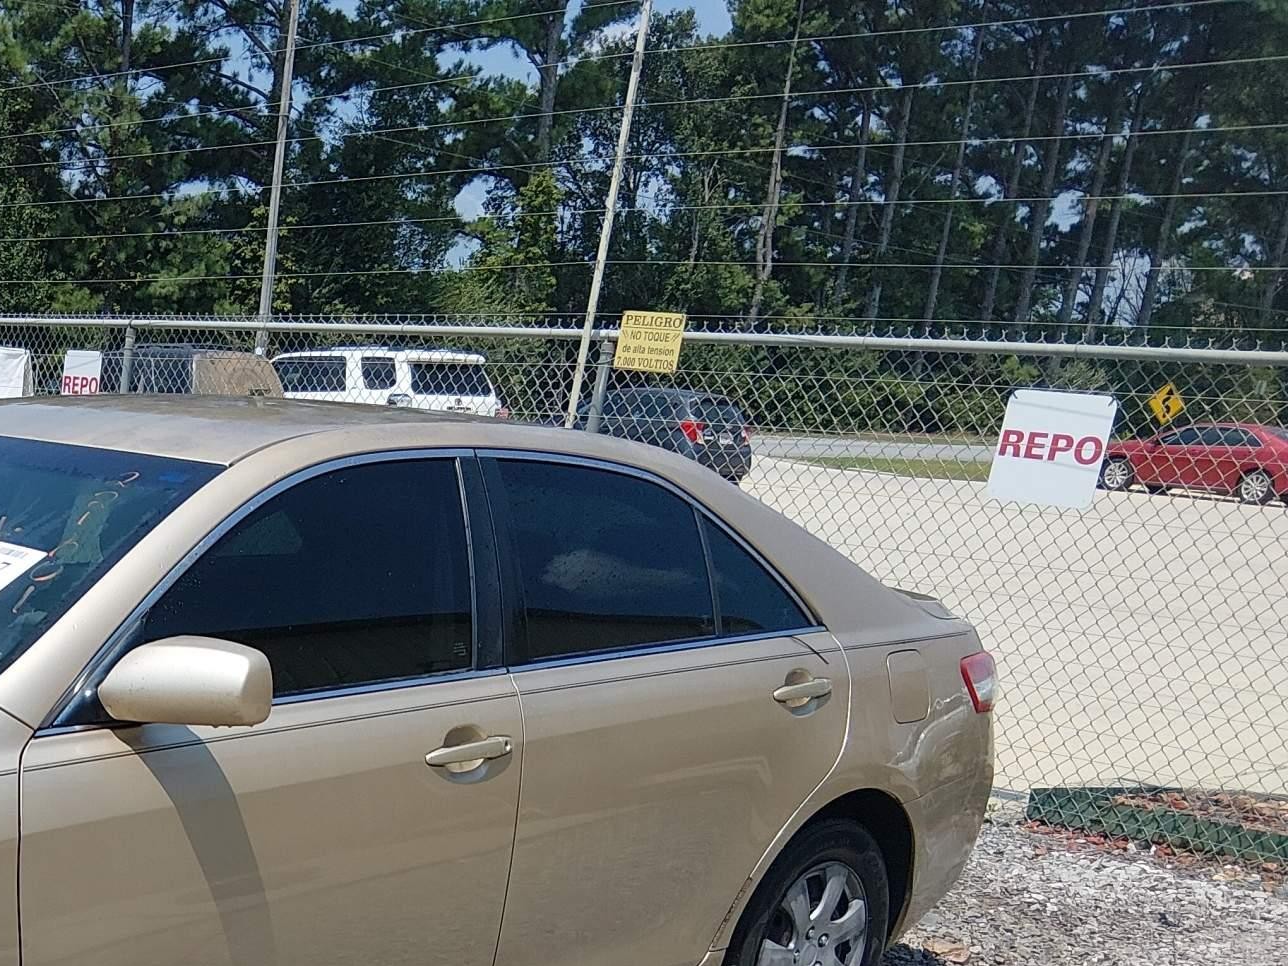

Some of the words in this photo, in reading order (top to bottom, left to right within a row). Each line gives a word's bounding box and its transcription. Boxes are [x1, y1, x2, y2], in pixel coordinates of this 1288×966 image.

[624, 314, 683, 328] PELIGRO
[630, 330, 642, 341] NO
[643, 331, 671, 343] TOQUE
[622, 344, 631, 353] de
[632, 345, 646, 354] alta
[647, 346, 674, 356] tension
[637, 357, 674, 370] VOLTIOS
[63, 375, 99, 394] REPO
[998, 429, 1103, 465] REPO
